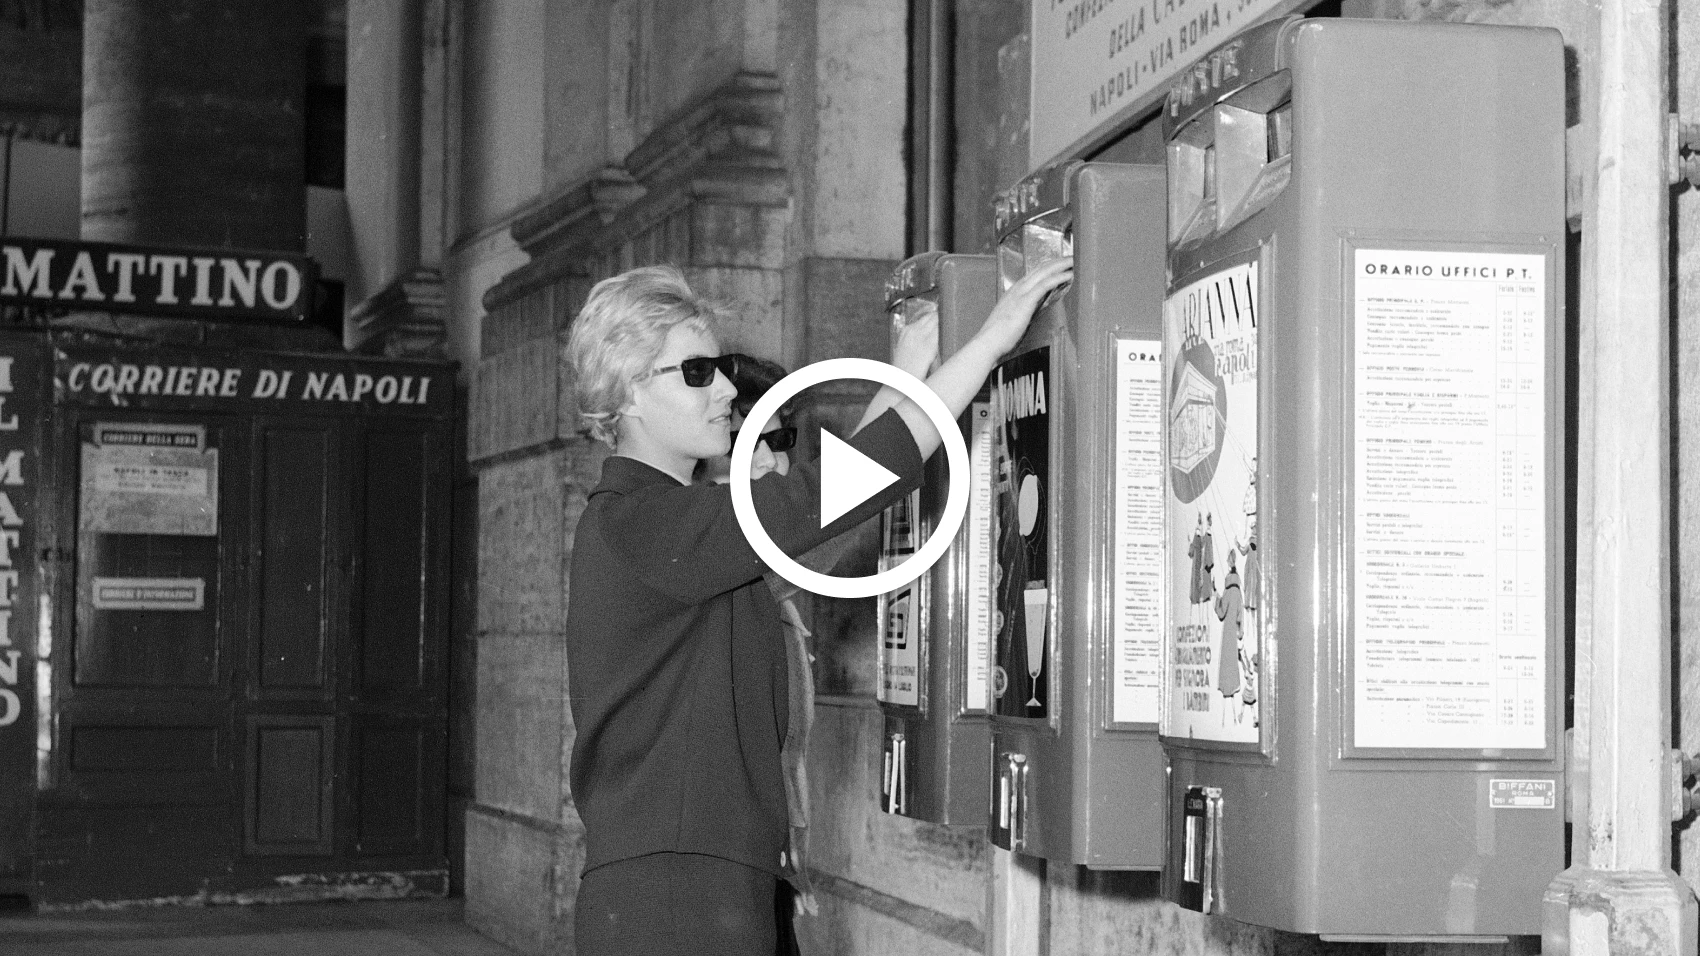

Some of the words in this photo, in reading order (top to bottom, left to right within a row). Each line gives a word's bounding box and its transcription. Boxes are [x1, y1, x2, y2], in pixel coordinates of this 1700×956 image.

[1109, 7, 1145, 59] DELLA
[1, 245, 301, 310] MATTINO
[1365, 263, 1433, 277] ORARIO
[1441, 265, 1497, 278] UFFICI
[68, 363, 241, 397] CORRIERE
[251, 369, 293, 399] DI
[301, 372, 431, 404] NAPOLI
[1499, 782, 1546, 791] BIFFANI
